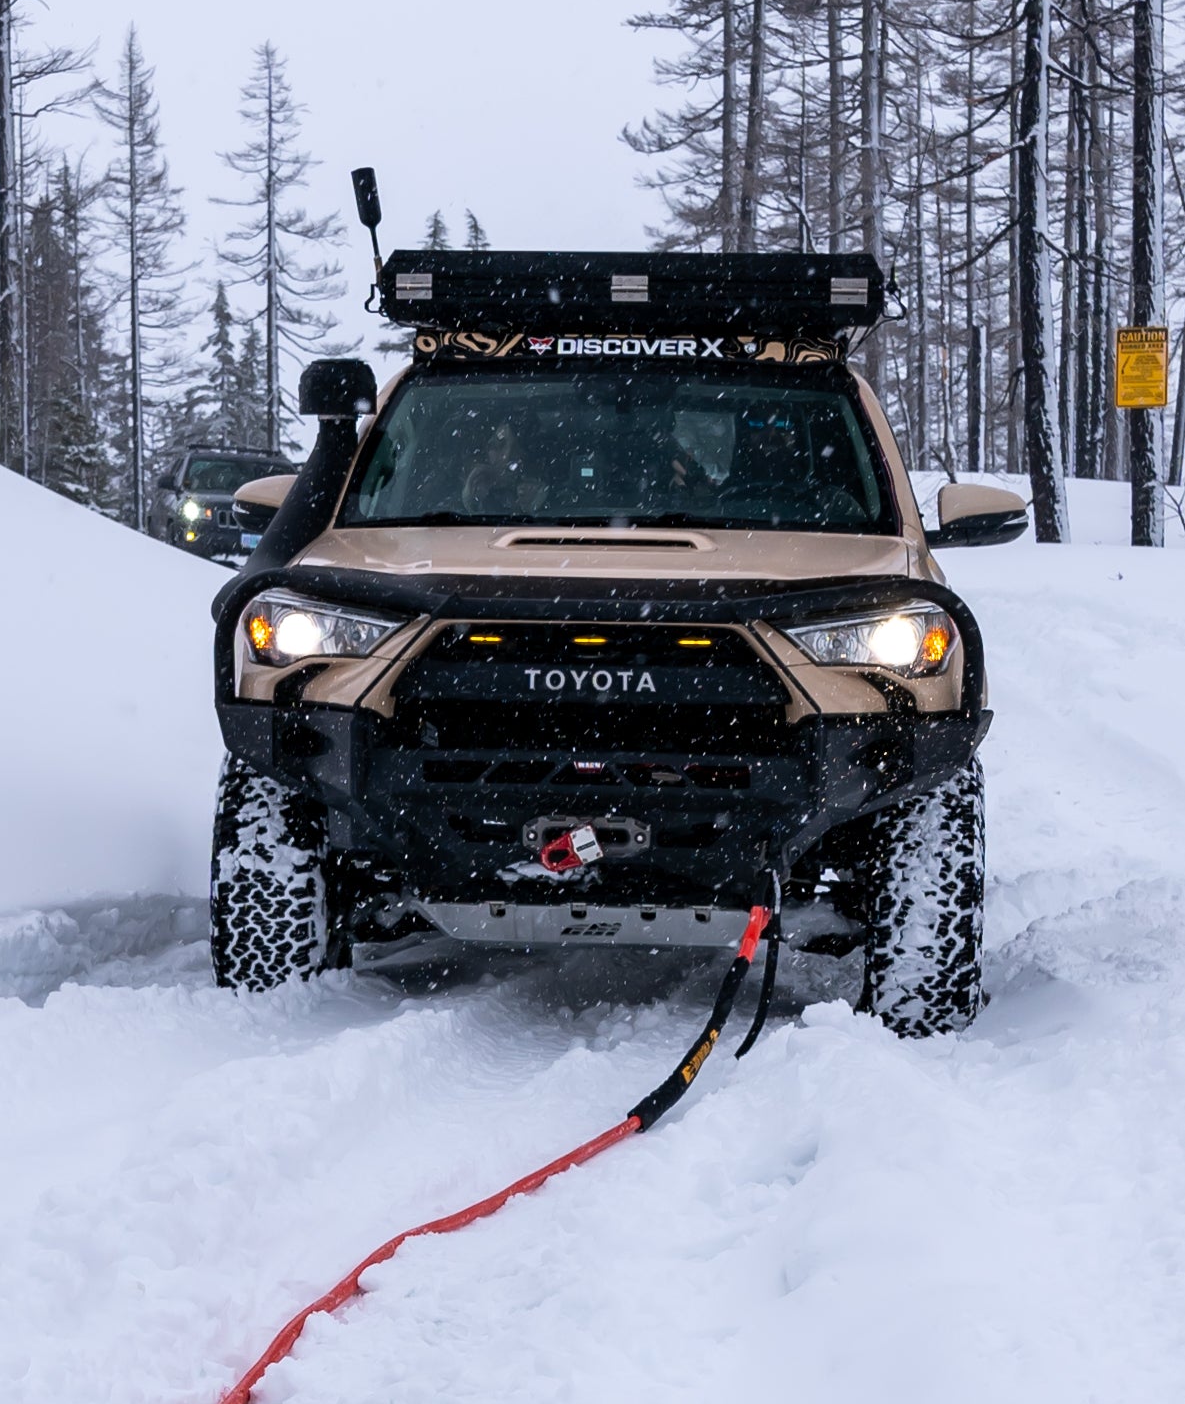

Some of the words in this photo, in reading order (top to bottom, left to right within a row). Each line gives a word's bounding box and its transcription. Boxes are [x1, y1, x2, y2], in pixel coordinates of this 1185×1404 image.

[557, 338, 697, 356] DISCOVER
[701, 337, 725, 358] X
[1119, 331, 1166, 343] CAUTION
[524, 669, 657, 693] TOYOTA
